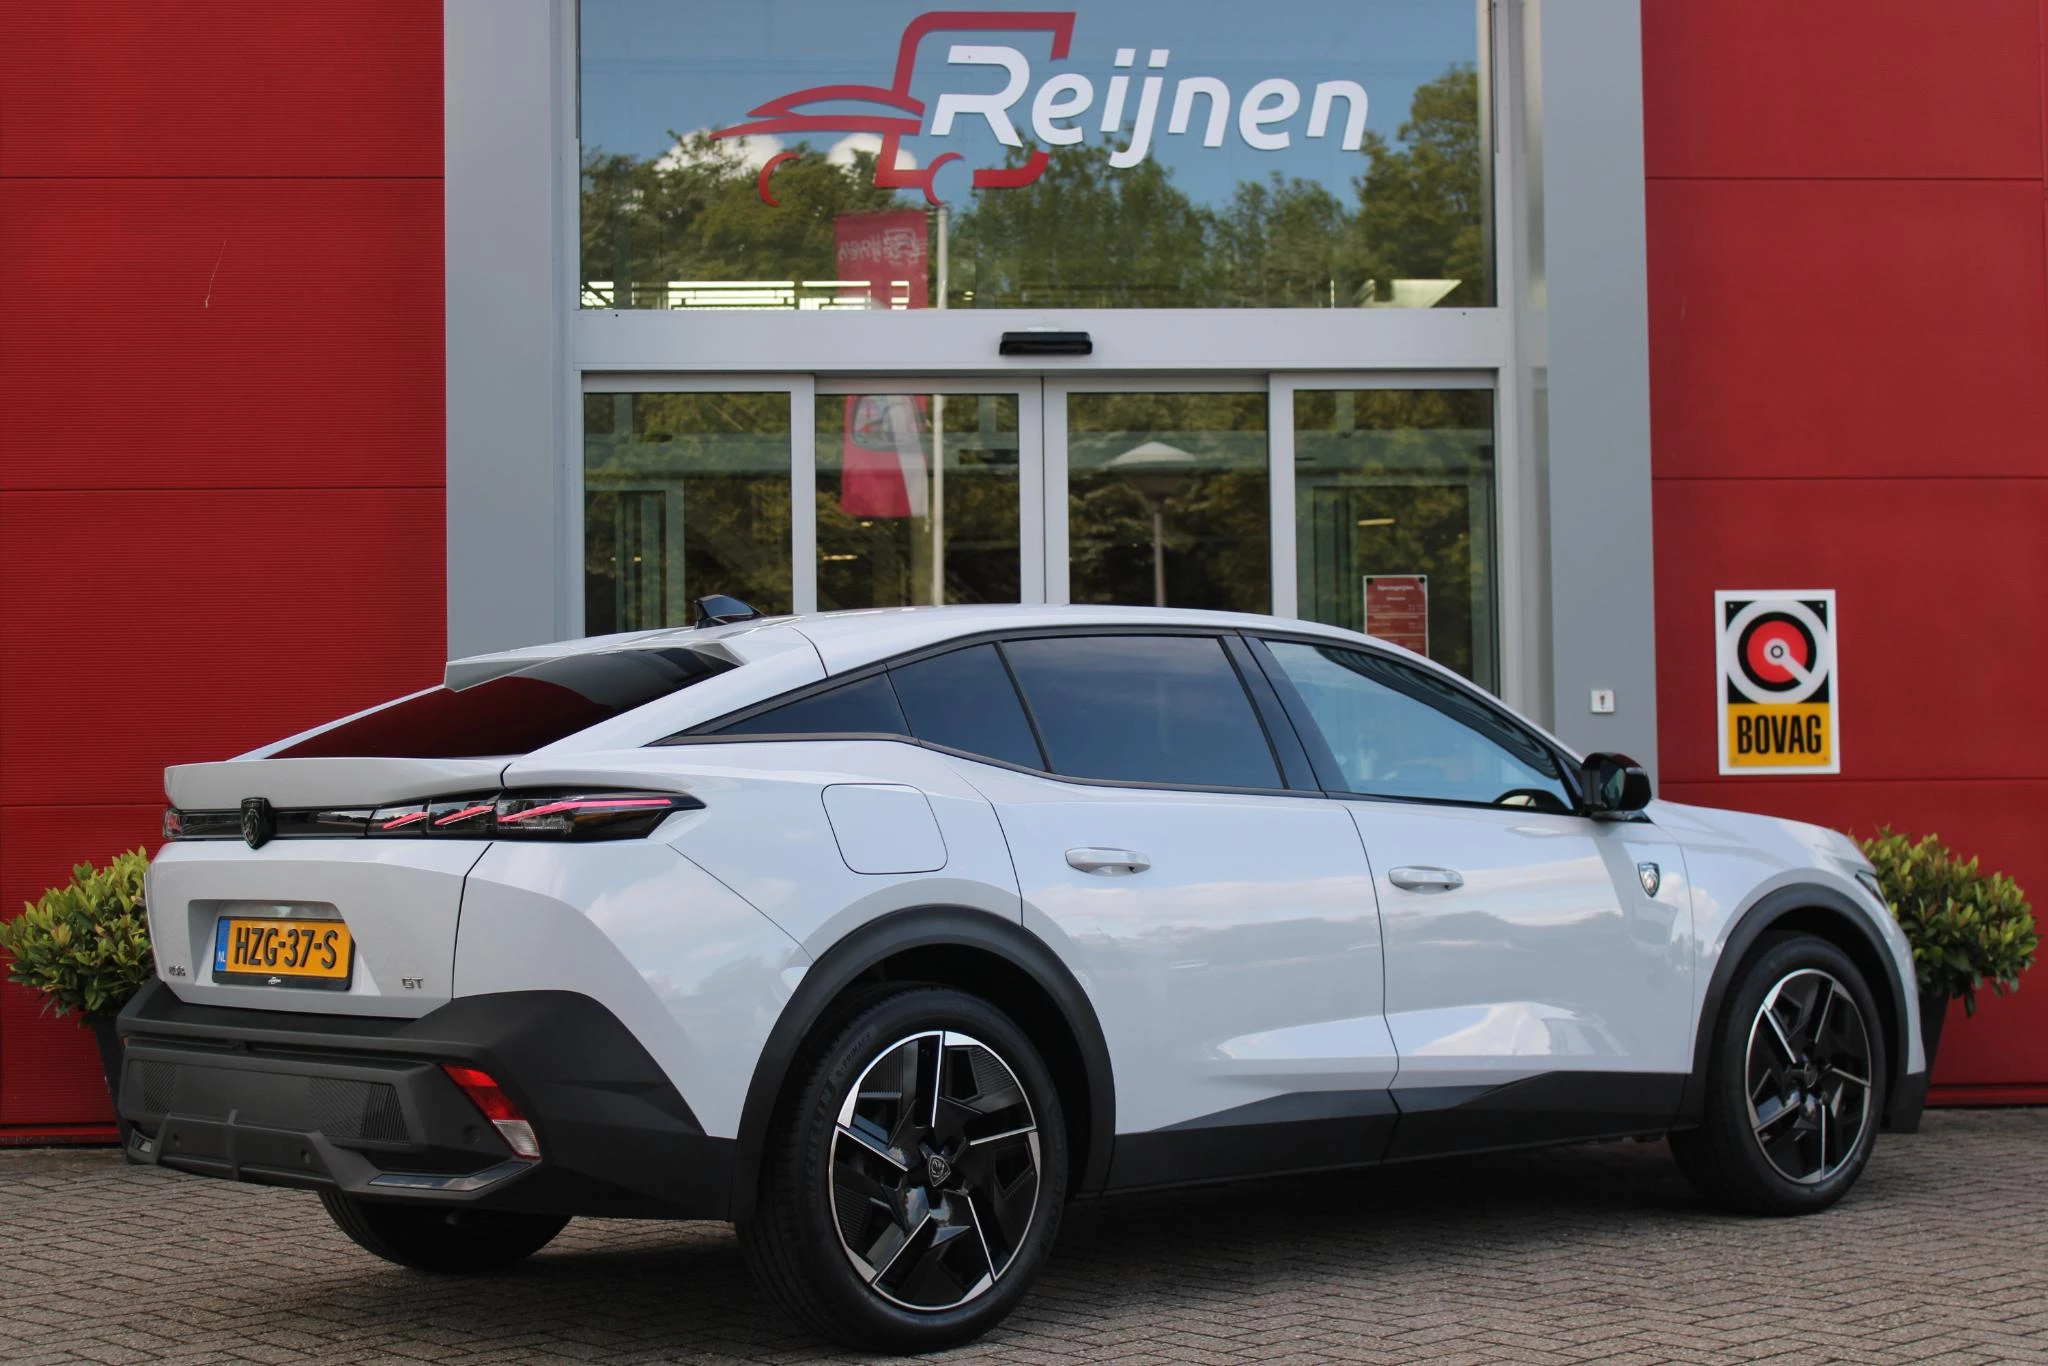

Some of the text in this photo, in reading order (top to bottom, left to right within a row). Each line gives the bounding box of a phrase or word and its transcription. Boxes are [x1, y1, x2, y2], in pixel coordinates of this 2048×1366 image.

[930, 45, 1369, 169] Reijnen
[1737, 714, 1822, 754] BOVAG
[217, 951, 226, 962] NL
[234, 927, 338, 969] HZG-37-S
[401, 977, 424, 989] GT
